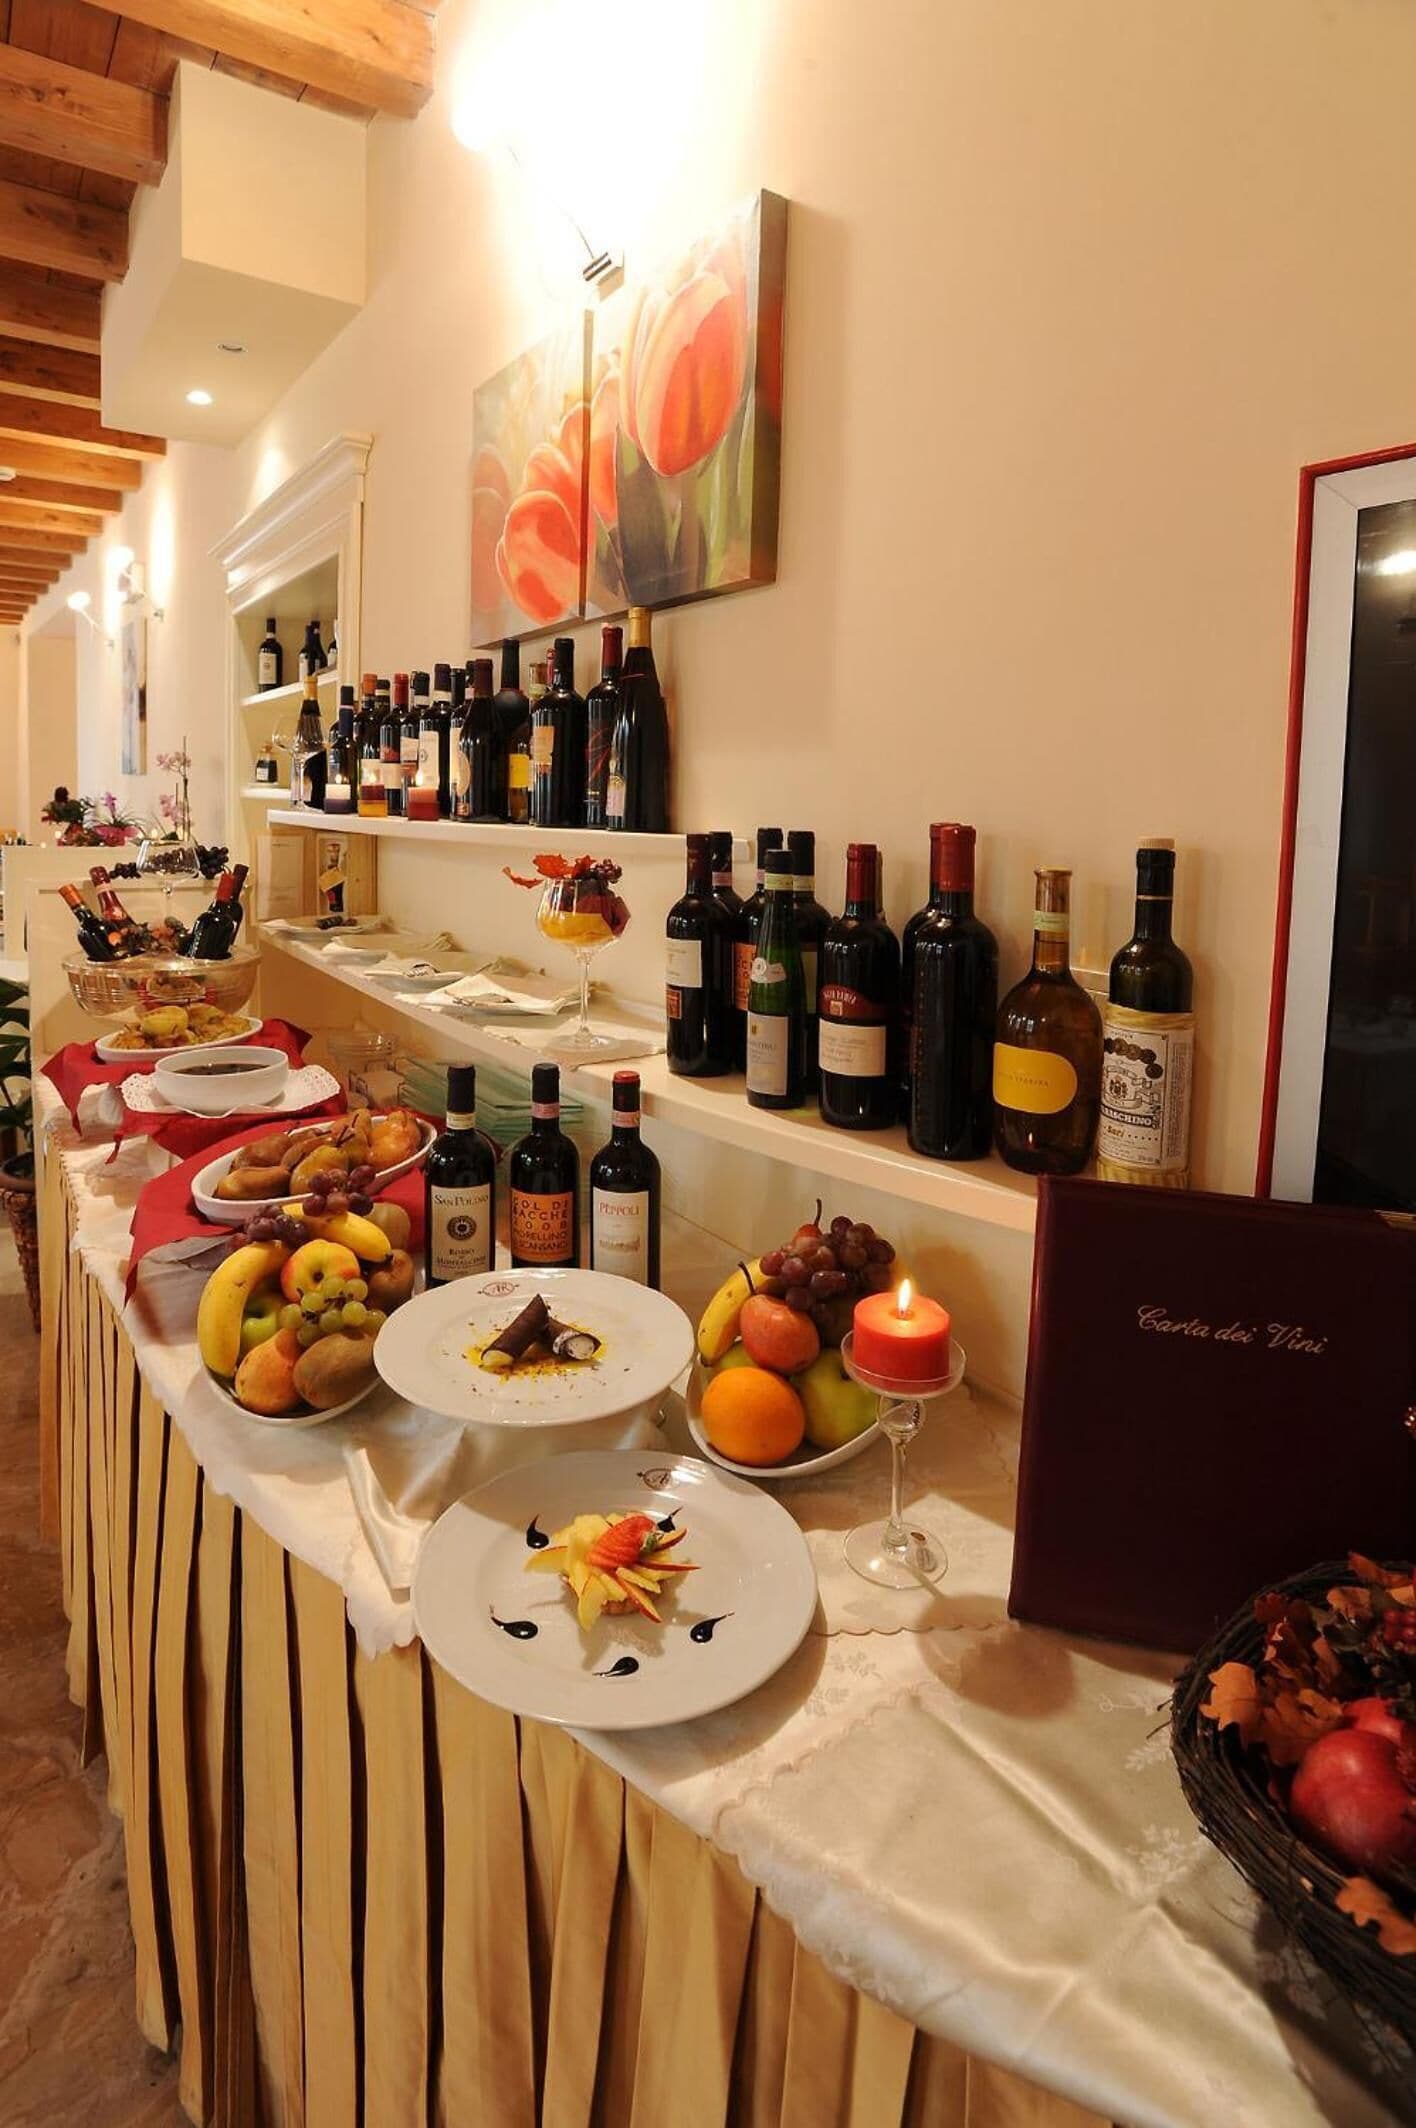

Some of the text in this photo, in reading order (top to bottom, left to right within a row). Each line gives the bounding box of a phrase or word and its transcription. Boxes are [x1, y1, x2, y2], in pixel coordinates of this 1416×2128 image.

[1137, 1305, 1328, 1354] Carta dei Vini
